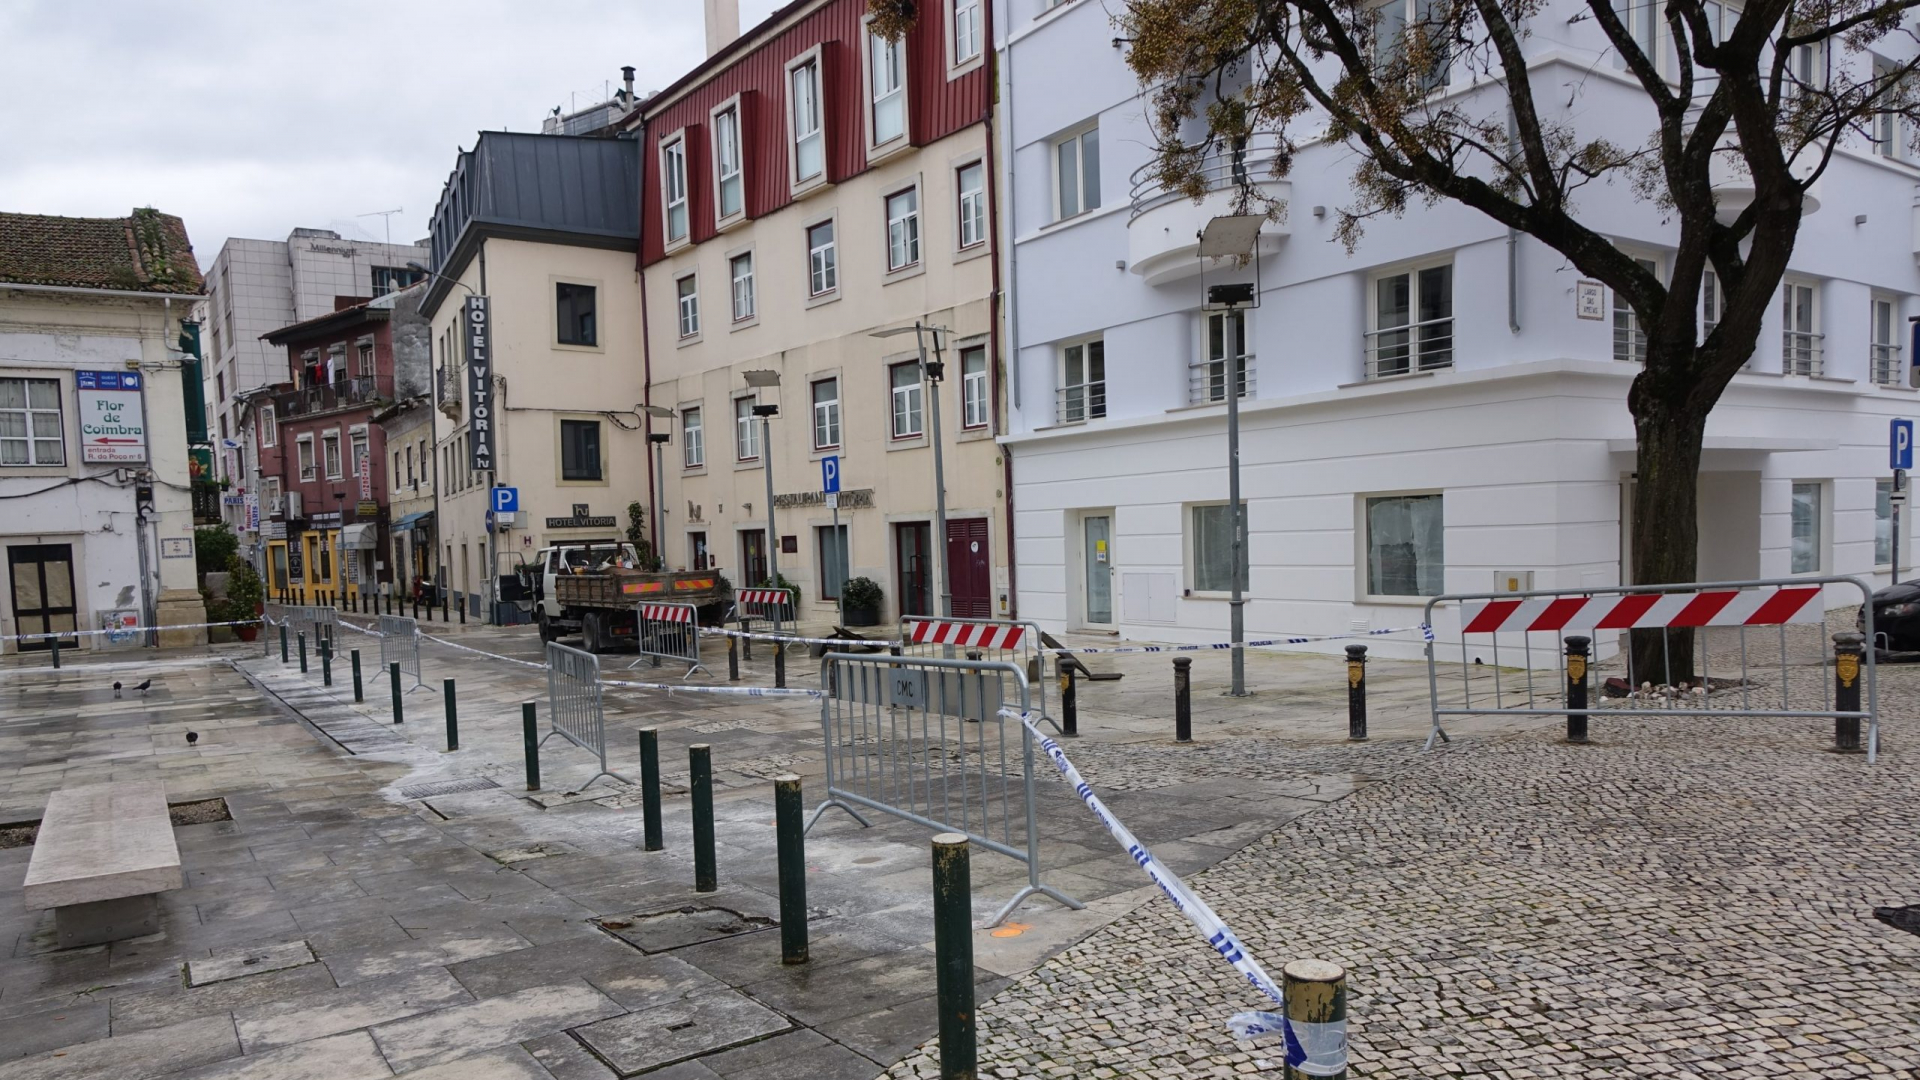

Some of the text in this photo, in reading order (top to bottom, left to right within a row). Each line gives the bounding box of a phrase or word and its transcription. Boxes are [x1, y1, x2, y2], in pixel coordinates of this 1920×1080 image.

[470, 297, 485, 360] HOTEL
[96, 400, 124, 411] Flor
[473, 366, 490, 455] VITÓRIA
[103, 413, 120, 423] de
[83, 424, 142, 435] Coimbra
[1897, 426, 1908, 465] P
[825, 460, 836, 490] P
[497, 490, 513, 510] P
[774, 491, 827, 507] RESTAURANT
[549, 519, 578, 527] HOTEL
[897, 680, 913, 697] CMC
